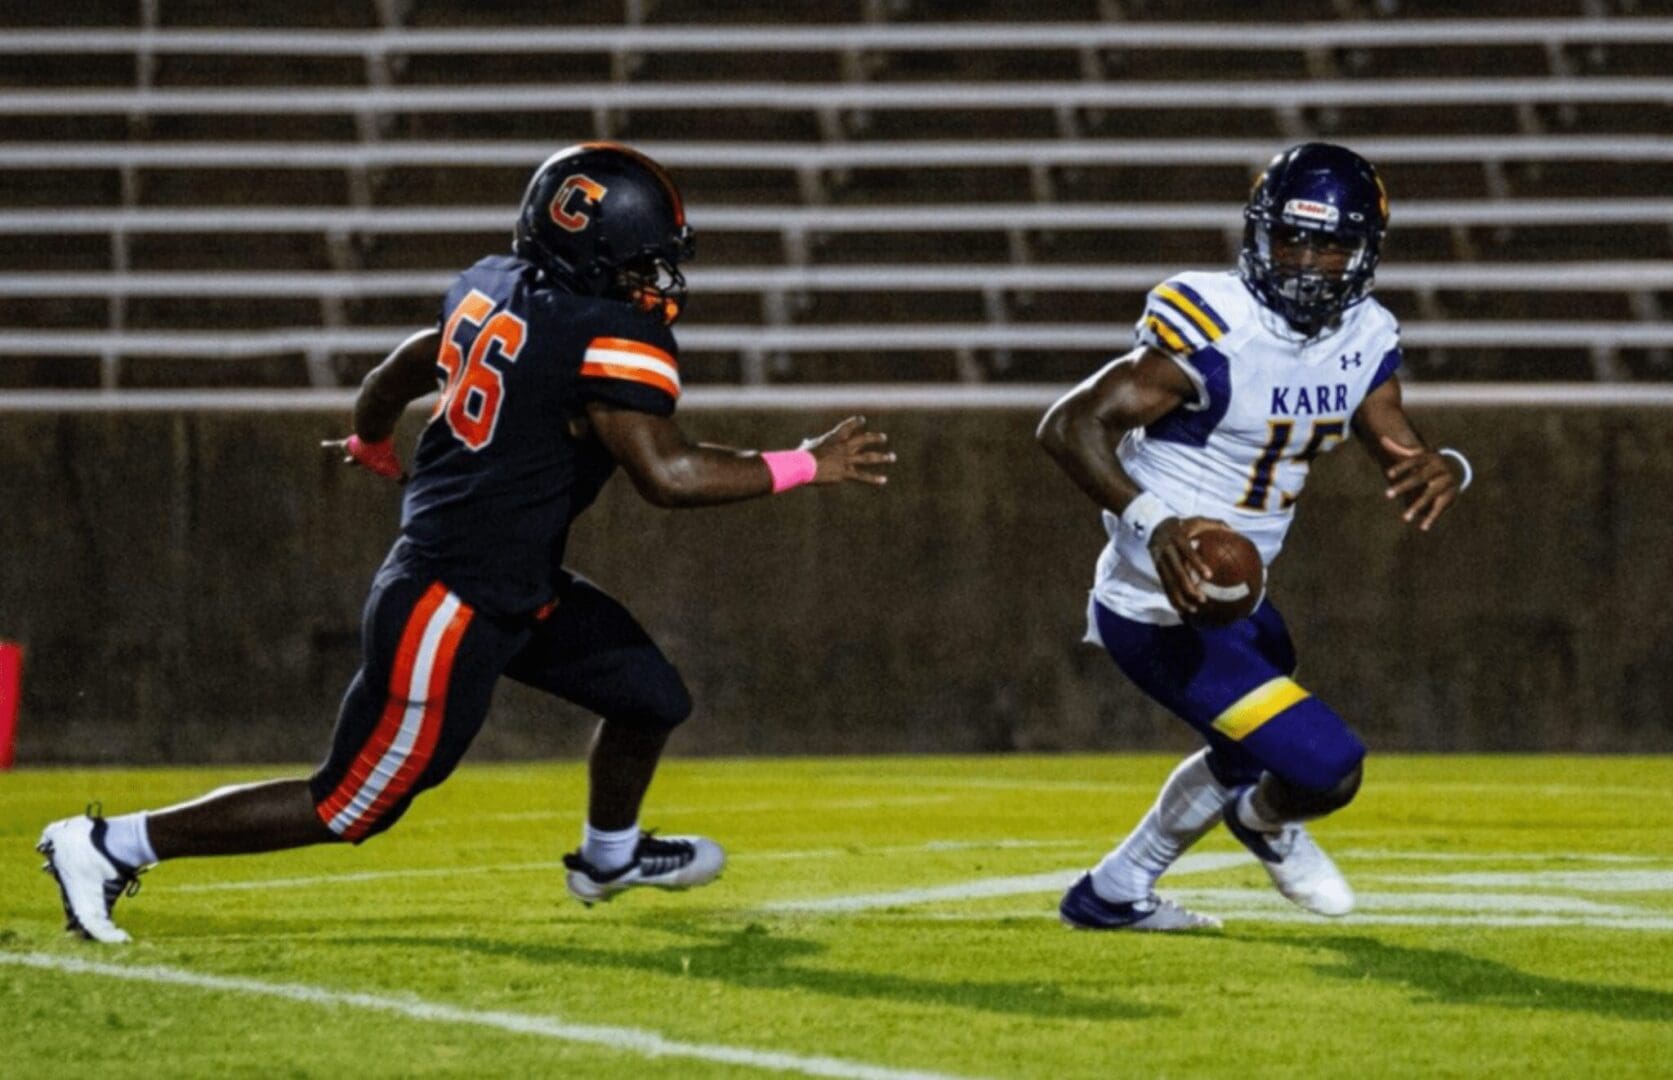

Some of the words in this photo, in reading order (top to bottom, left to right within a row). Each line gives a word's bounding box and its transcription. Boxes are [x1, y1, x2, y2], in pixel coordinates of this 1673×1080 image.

[550, 173, 607, 232] C
[429, 289, 527, 452] 56
[1270, 384, 1348, 416] KARR
